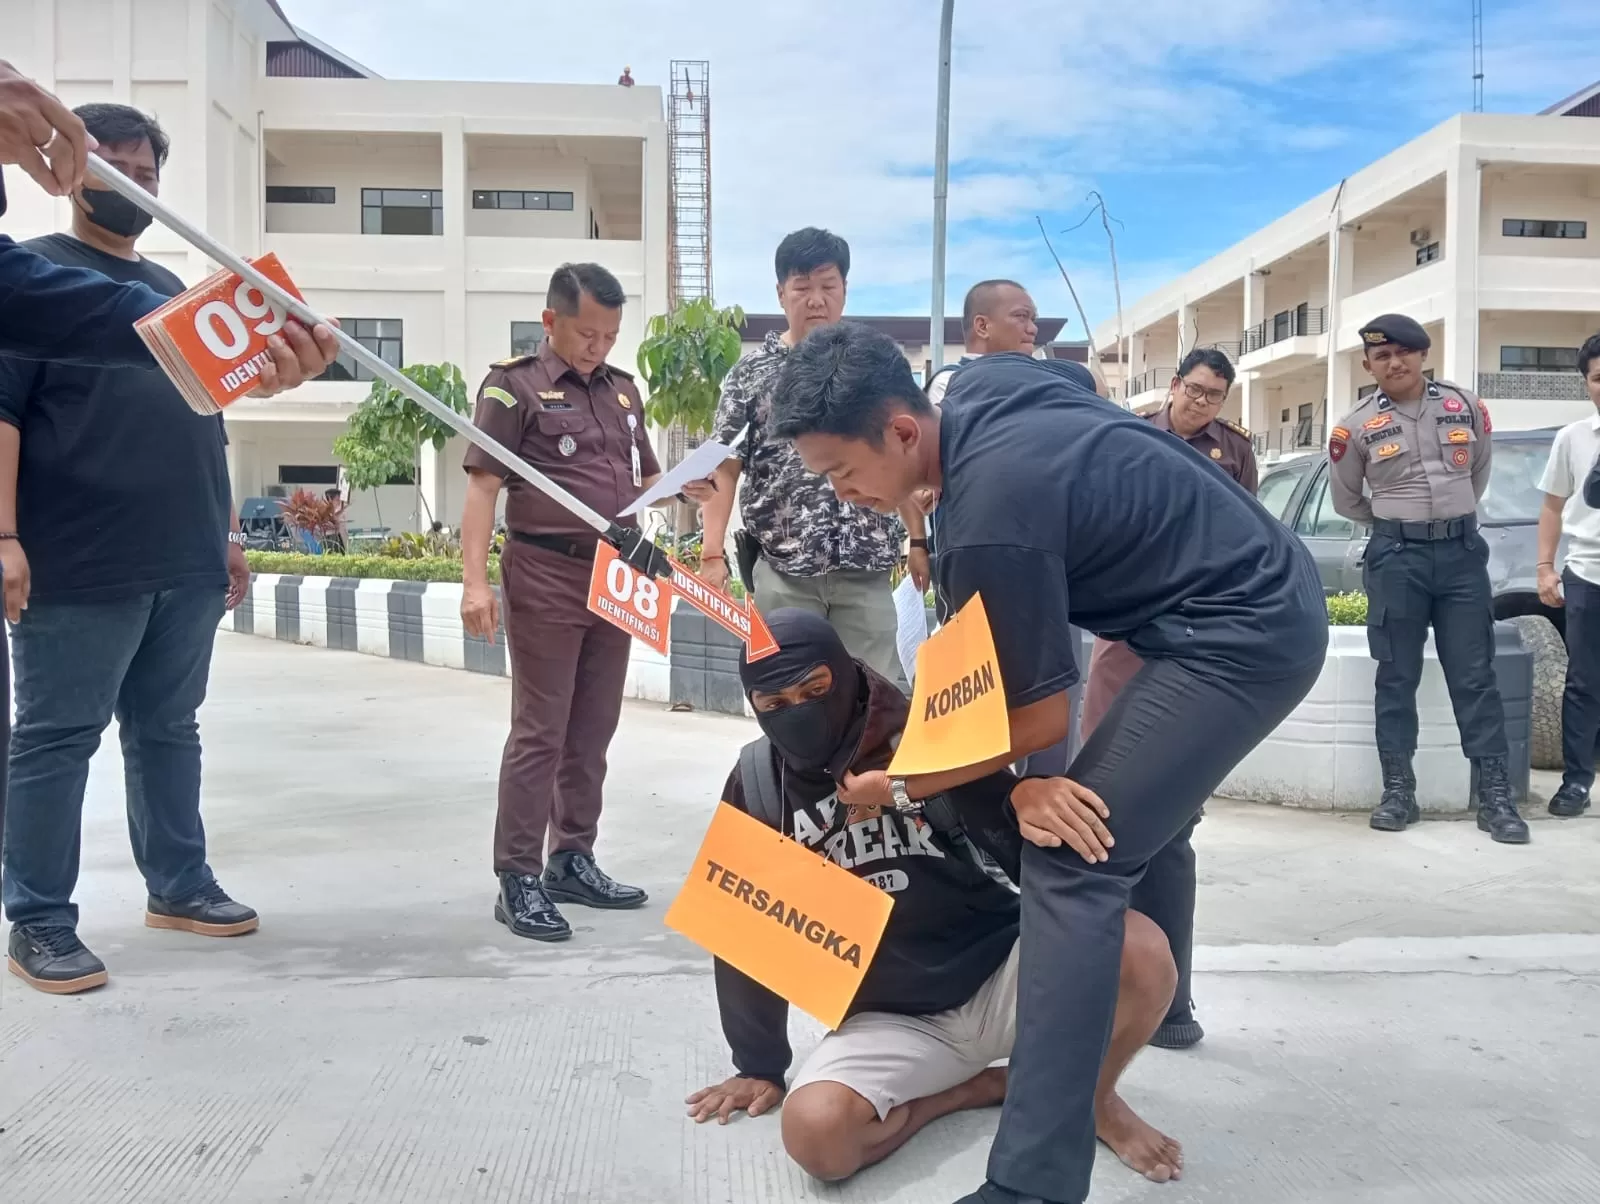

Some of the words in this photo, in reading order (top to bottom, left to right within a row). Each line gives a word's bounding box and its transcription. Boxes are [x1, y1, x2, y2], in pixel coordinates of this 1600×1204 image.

[194, 281, 287, 360] 09
[220, 348, 276, 392] IDENTI
[1436, 415, 1471, 425] POLRI
[597, 595, 660, 642] IDENTIFIKASI
[606, 558, 660, 619] 08
[674, 570, 751, 635] IDENTIFIKASI
[924, 660, 995, 722] KORBAN
[816, 813, 945, 870] REAK
[707, 860, 863, 969] TERSANGKA
